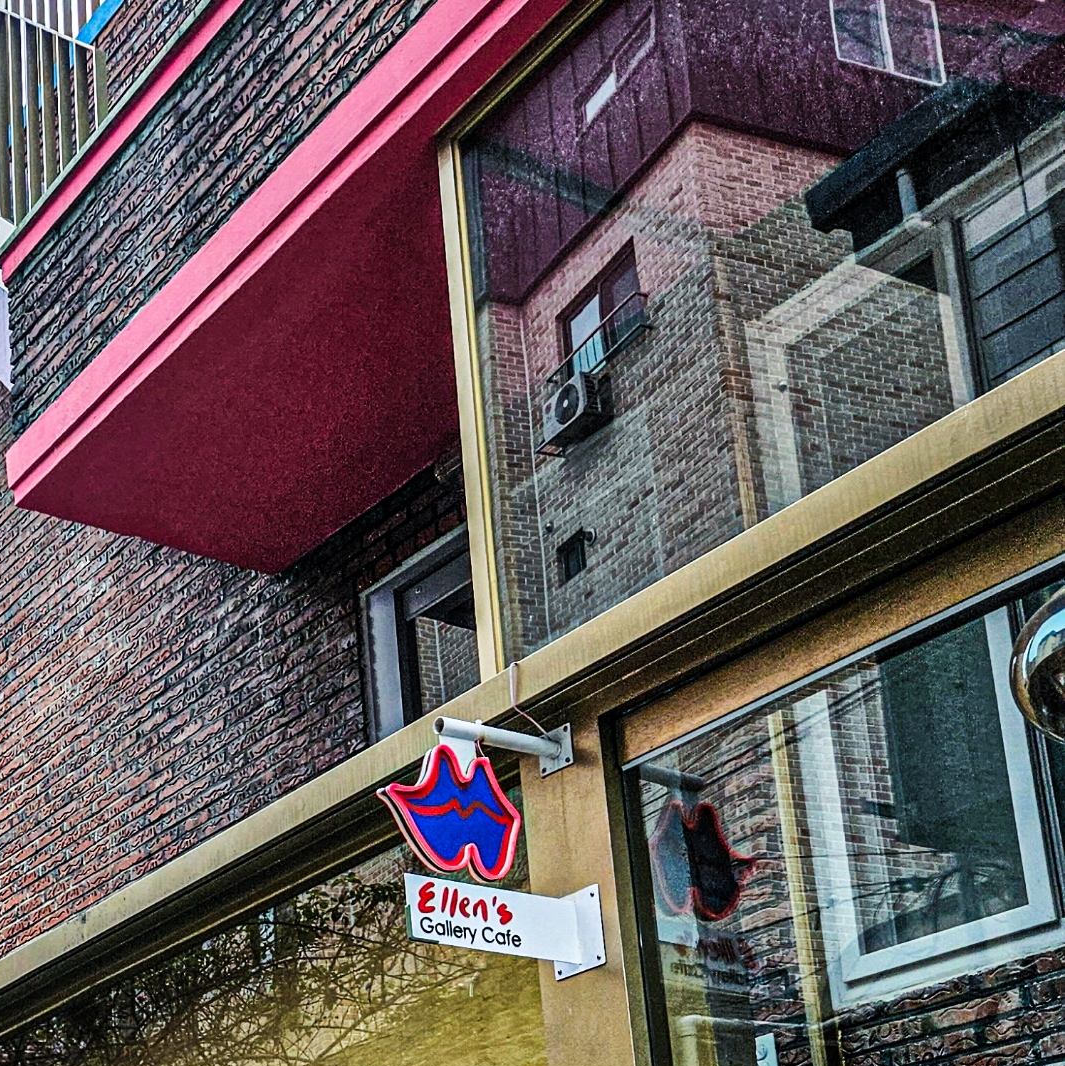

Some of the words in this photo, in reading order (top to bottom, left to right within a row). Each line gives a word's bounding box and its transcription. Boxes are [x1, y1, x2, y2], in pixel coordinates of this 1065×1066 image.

[418, 881, 514, 926] Ellen's
[420, 916, 478, 945] Gallery
[482, 926, 522, 948] Cafe
